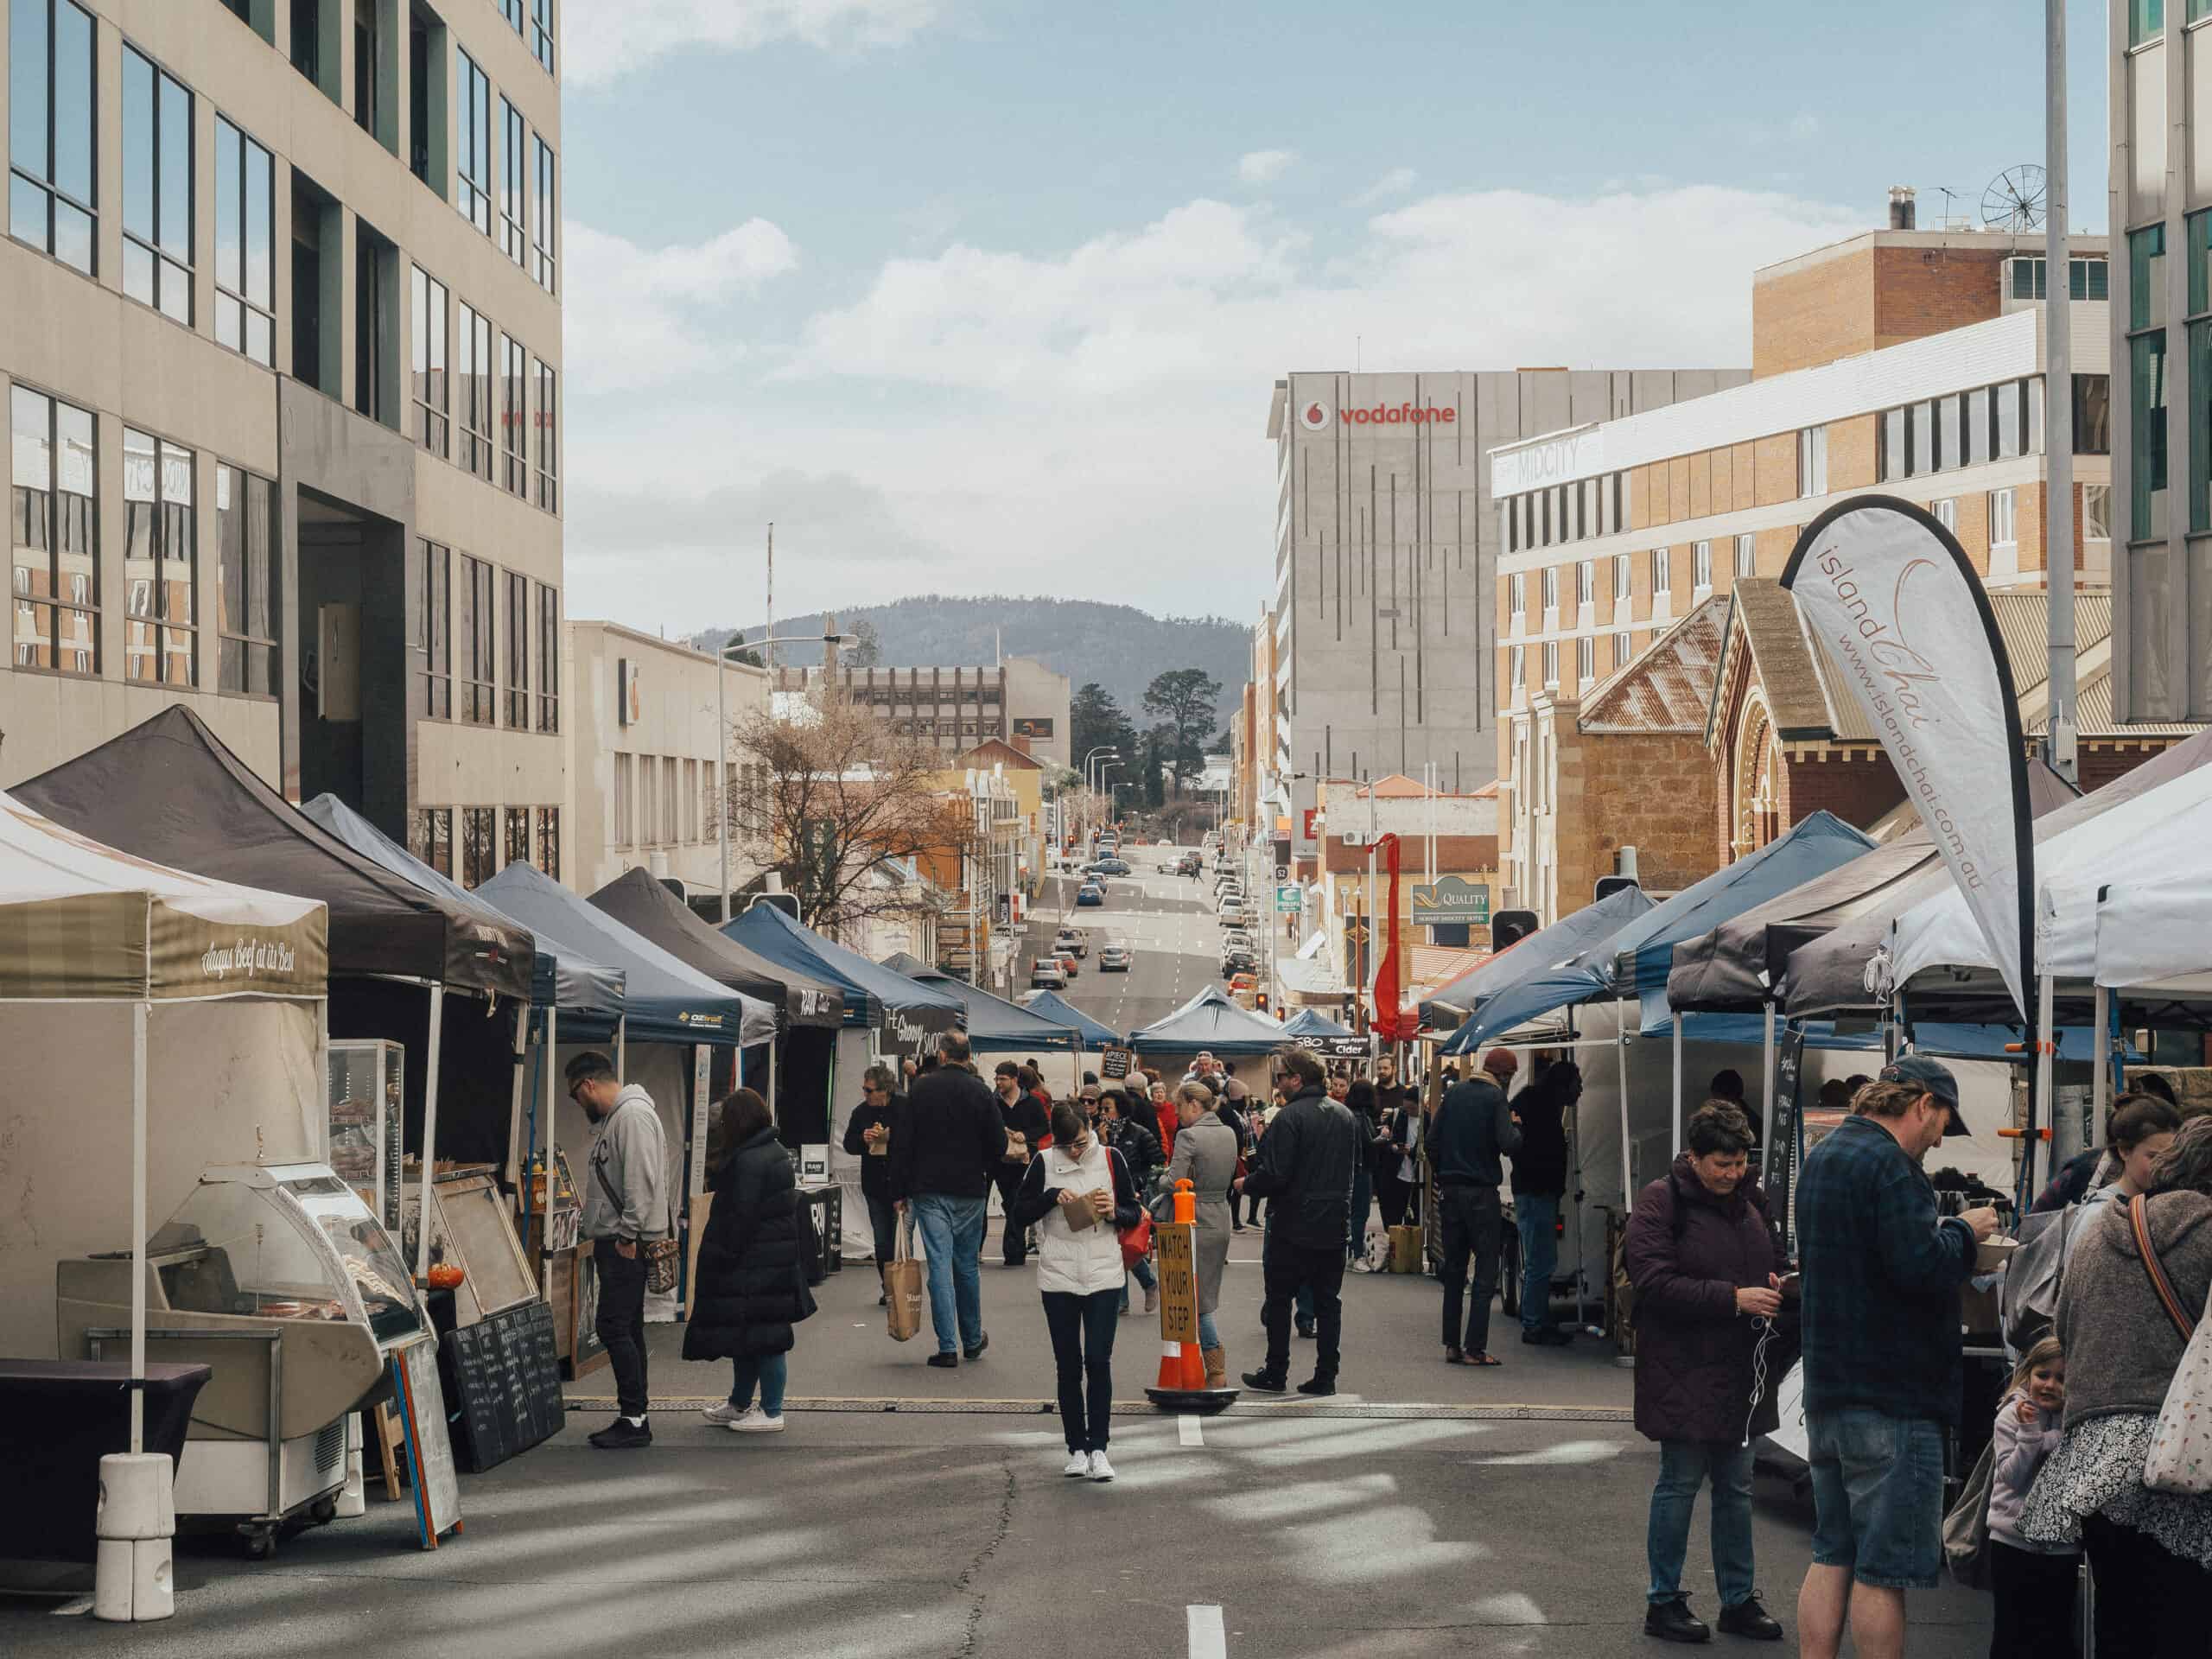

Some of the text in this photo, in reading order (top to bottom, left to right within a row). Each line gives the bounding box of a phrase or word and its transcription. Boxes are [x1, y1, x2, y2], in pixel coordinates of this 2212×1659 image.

[1340, 403, 1456, 424] vodafone
[1518, 439, 1579, 485] MIDCITY
[1816, 545, 1887, 639] island
[1839, 633, 1985, 892] www.islandchai.com.au
[1443, 893, 1487, 906] QUALITY
[201, 940, 233, 980] Angus
[234, 938, 256, 977] Beef
[256, 943, 266, 969] at
[800, 988, 817, 1016] RAW
[885, 1008, 898, 1030] THE
[1335, 1045, 1363, 1054] Cider
[1160, 1234, 1189, 1259] WATCH
[1165, 1271, 1189, 1295] YOUR
[1167, 1306, 1189, 1332] STEP
